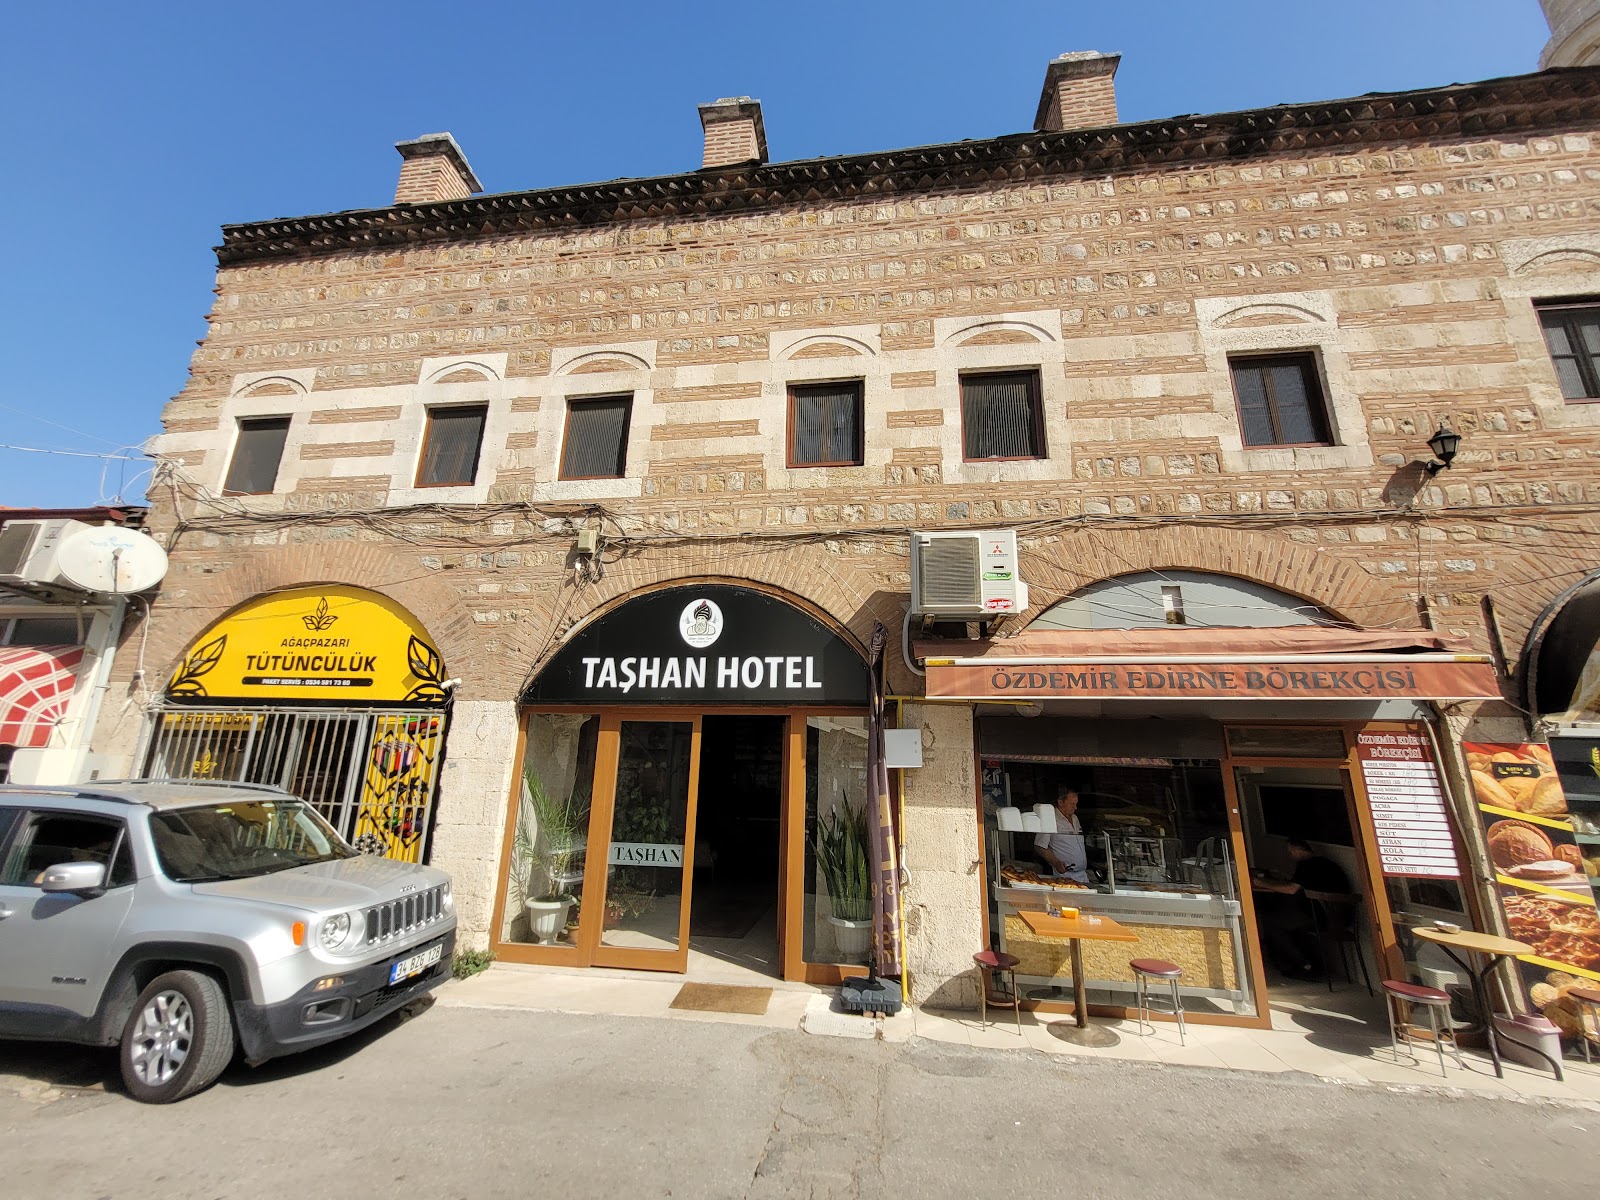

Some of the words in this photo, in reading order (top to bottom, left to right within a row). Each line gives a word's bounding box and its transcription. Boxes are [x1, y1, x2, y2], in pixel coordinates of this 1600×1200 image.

[281, 636, 350, 649] AĞAÇPAZARI
[246, 651, 377, 672] TÜTÜNCÜLÜK
[582, 656, 706, 693] TAŞHAN
[717, 656, 822, 688] HOTEL
[991, 667, 1119, 690] ÖZDEMİR
[1127, 666, 1237, 690] EDİRNE
[1246, 665, 1417, 694] BÖREKÇİSİ
[1357, 733, 1397, 744] ÖZDEMİR
[1370, 746, 1423, 760] BÖREKÇİSİ
[613, 847, 681, 864] TAŞHAN
[396, 962, 407, 977] 34
